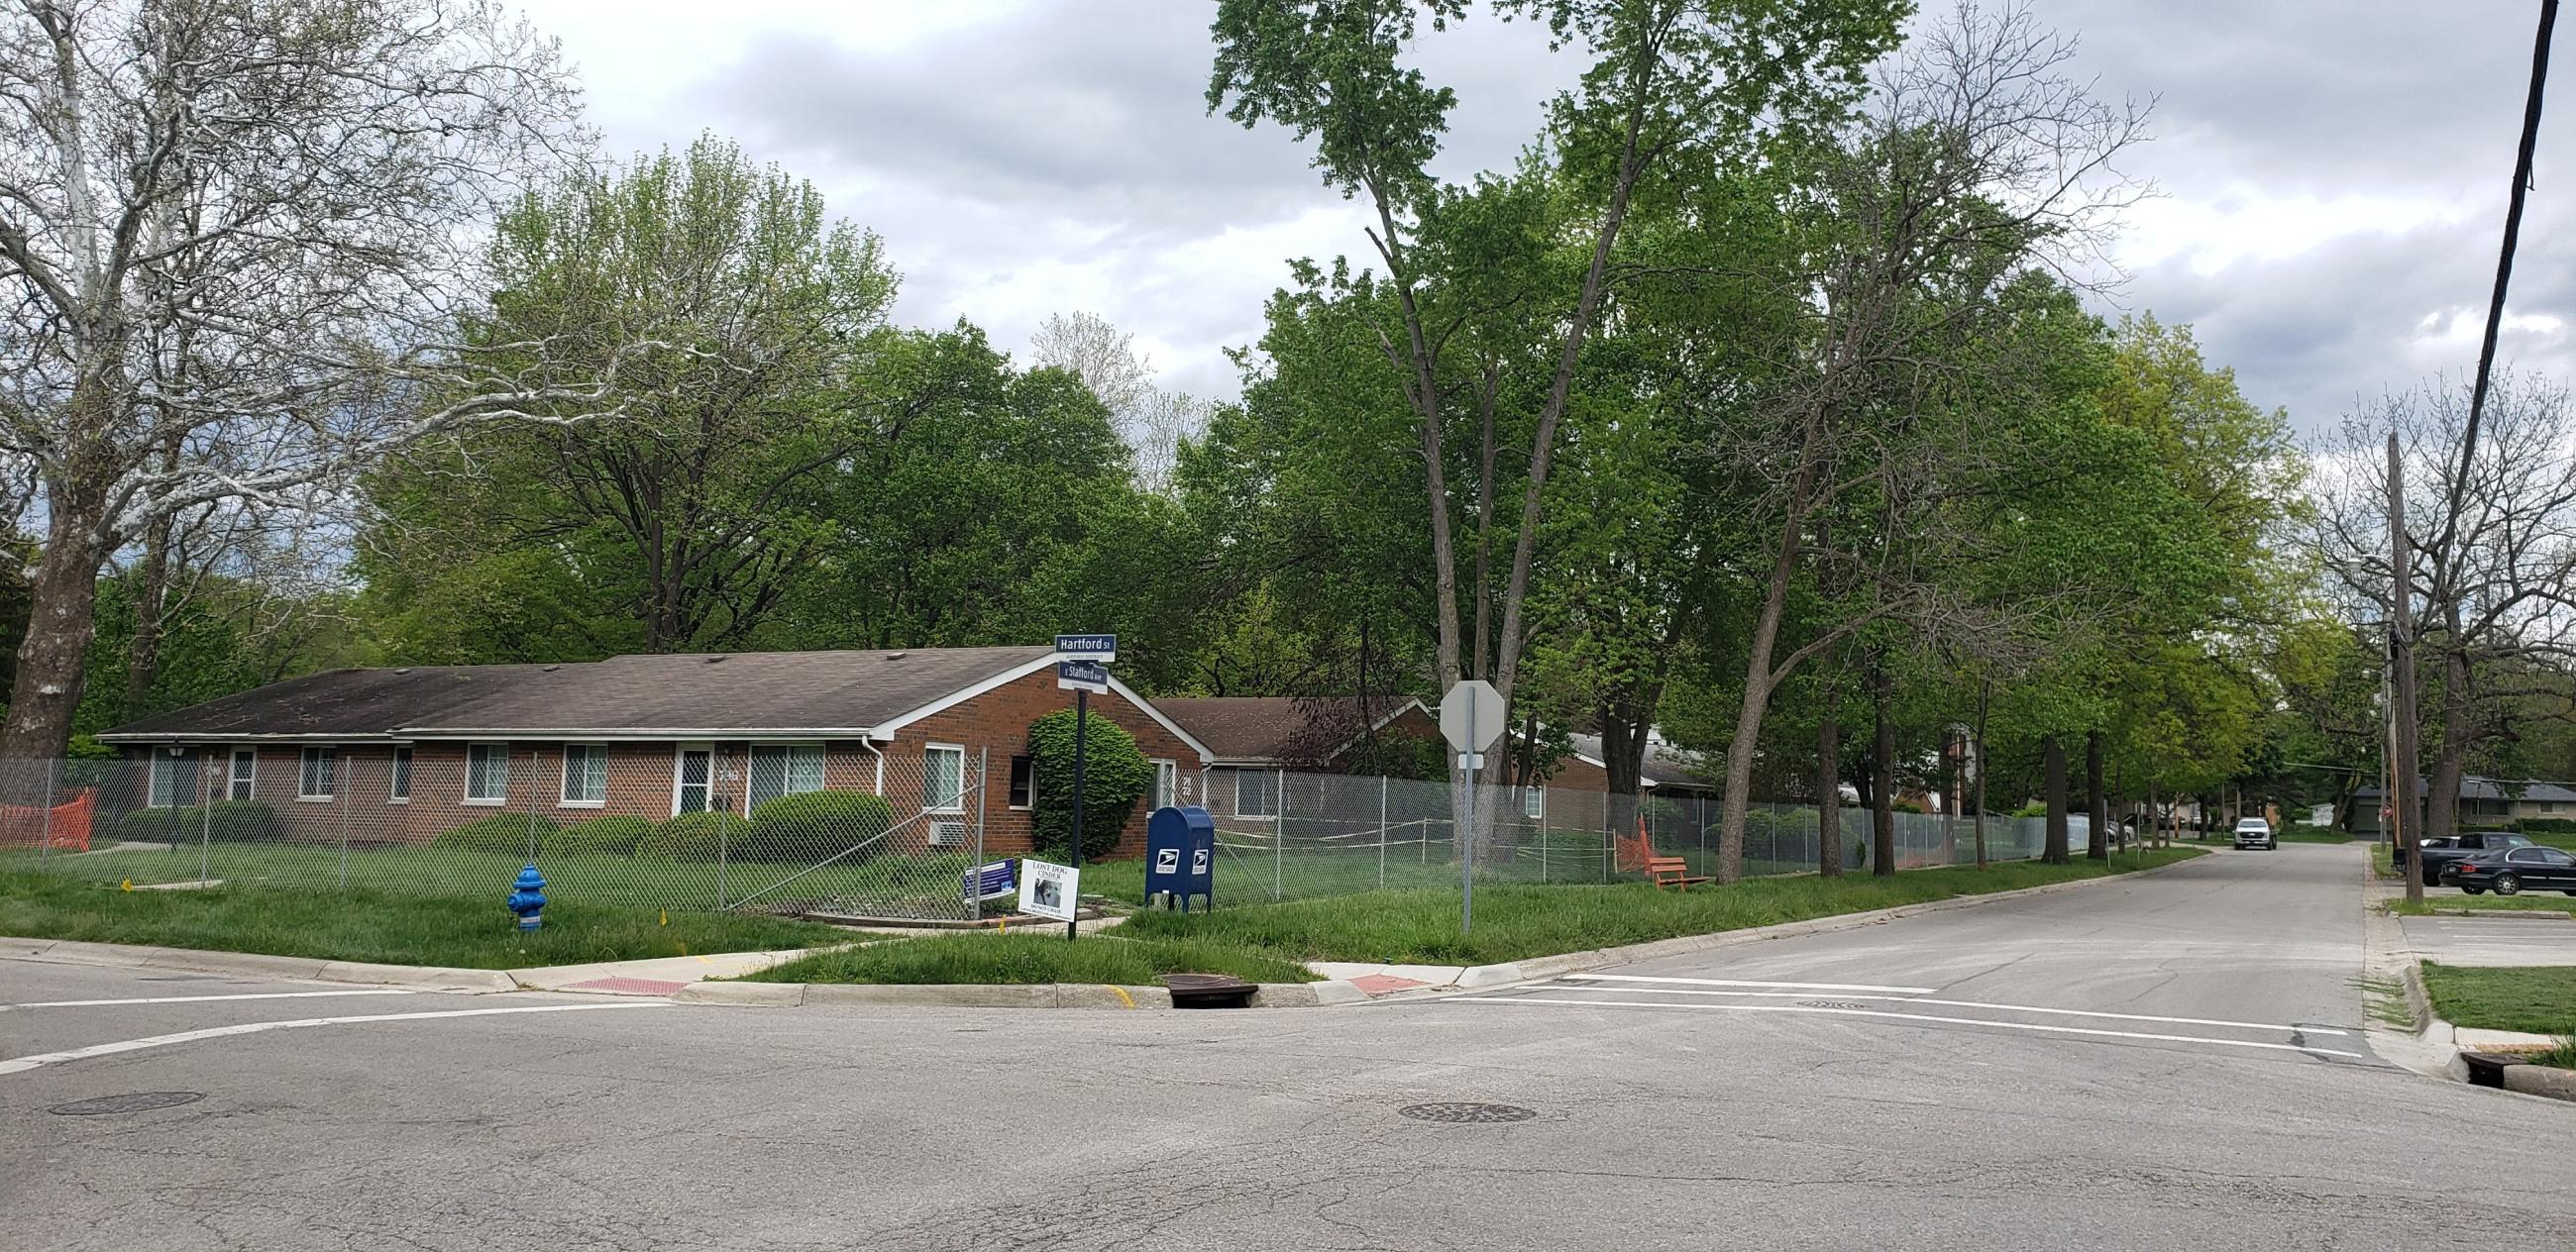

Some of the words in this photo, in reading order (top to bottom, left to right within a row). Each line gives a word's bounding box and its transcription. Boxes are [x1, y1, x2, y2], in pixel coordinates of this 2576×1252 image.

[1061, 638, 1102, 649] Hartford
[1065, 668, 1069, 677] E
[1069, 666, 1094, 679] Stafford
[1032, 862, 1051, 872] LOST
[1052, 865, 1068, 875] DOG
